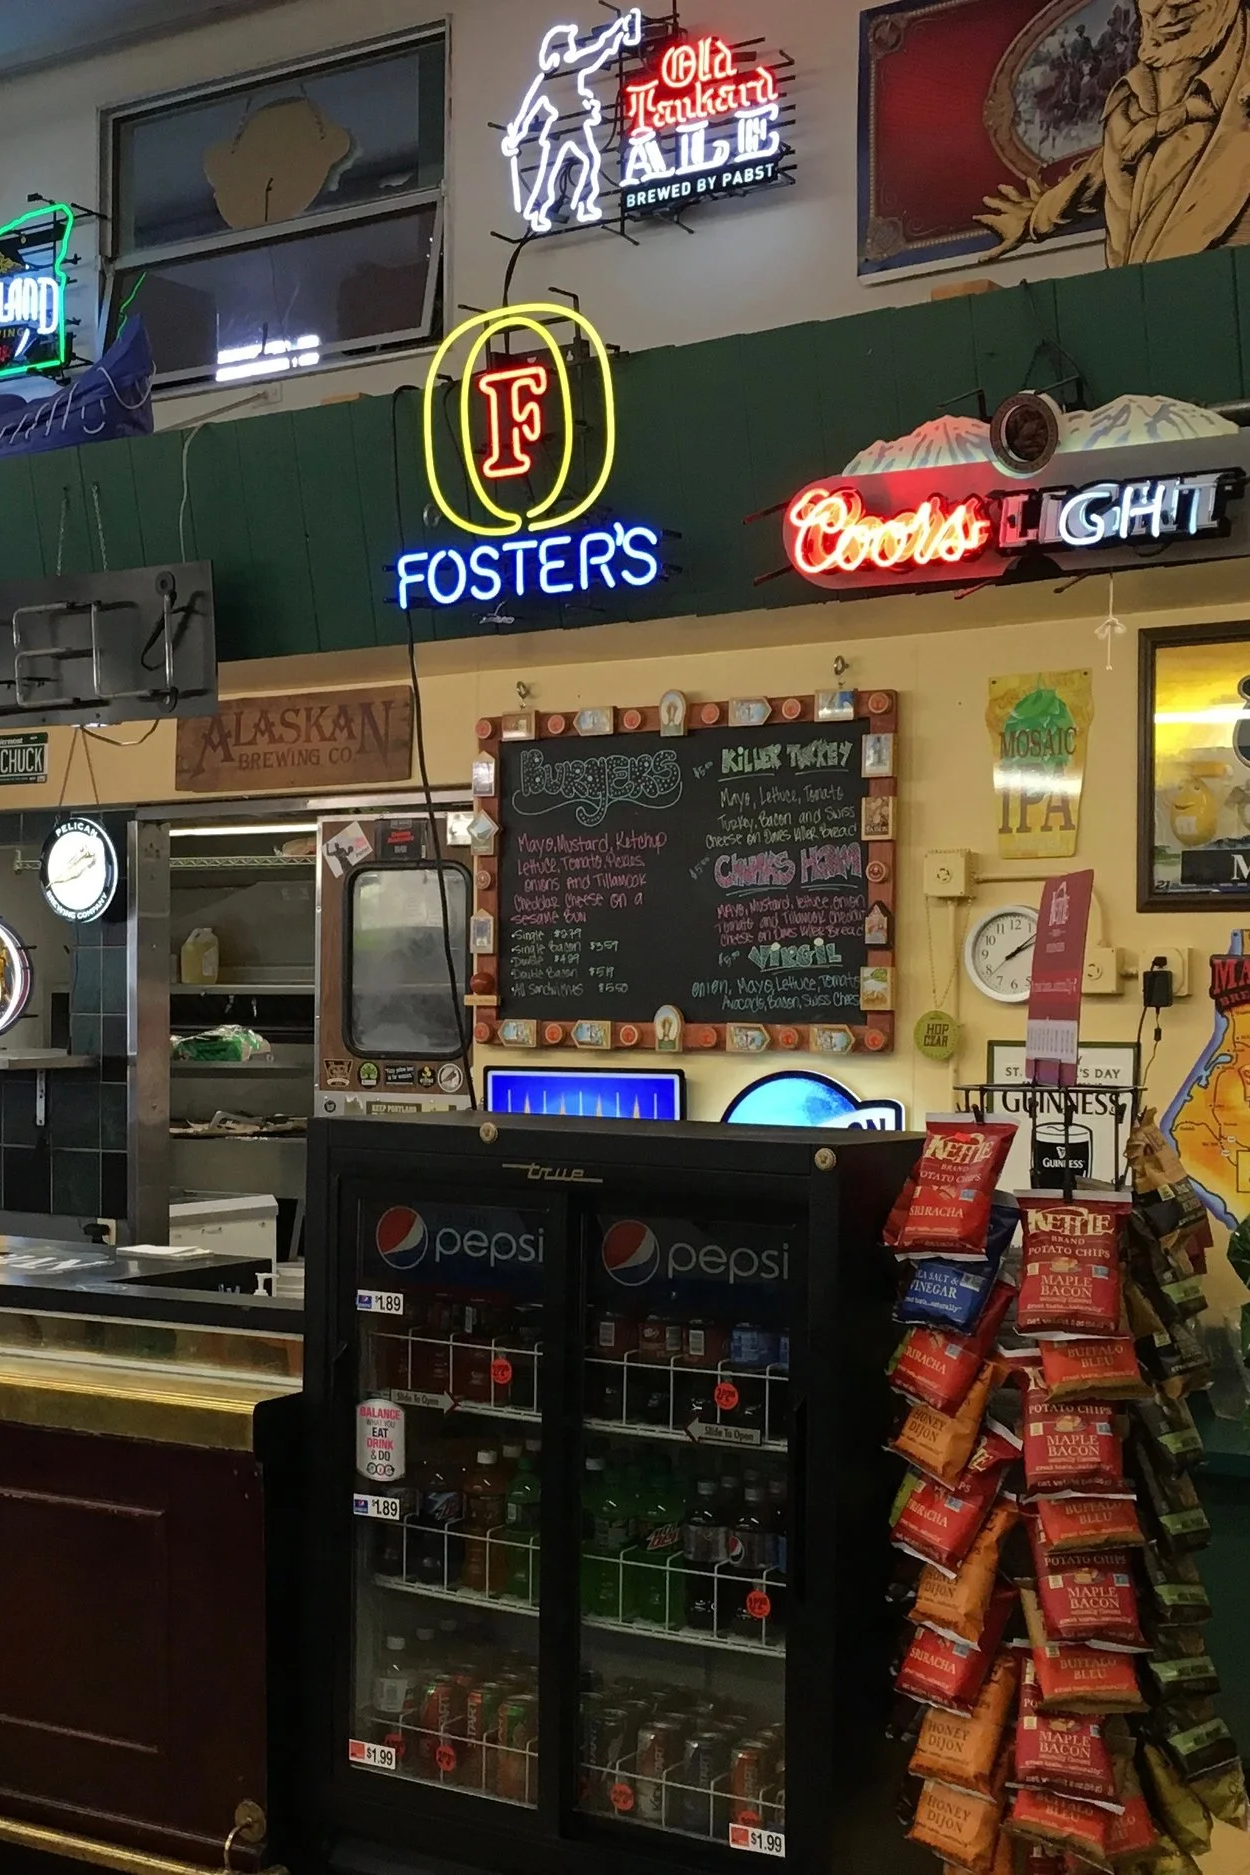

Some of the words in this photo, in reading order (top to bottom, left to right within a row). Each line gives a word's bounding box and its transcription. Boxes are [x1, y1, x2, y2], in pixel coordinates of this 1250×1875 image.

[662, 37, 737, 88] Old
[626, 66, 779, 136] Tankard
[620, 103, 780, 187] ALE
[626, 181, 692, 208] BREWED
[696, 175, 717, 191] BY
[723, 163, 776, 188] PABST
[479, 366, 547, 477] F
[790, 488, 989, 574] Coors
[999, 470, 1218, 549] LIGHT
[397, 522, 658, 609] FOSTER'S
[190, 700, 396, 780] ALASKAN
[1000, 726, 1078, 759] MOSAIC
[238, 749, 321, 771] BREWING
[997, 764, 1077, 834] IPA
[798, 808, 822, 824] and
[824, 805, 855, 821] Swiss
[55, 822, 98, 837] PELICAN
[76, 891, 108, 920] COMPANY
[995, 923, 1006, 935] 11
[1009, 918, 1022, 931] 12
[1026, 922, 1032, 933] 1
[985, 935, 996, 946] 10
[981, 949, 989, 960] 9
[985, 964, 993, 975] 8
[996, 976, 1004, 987] 7
[1010, 979, 1018, 990] 6
[925, 1023, 949, 1035] HOP
[923, 1034, 949, 1048] CZAR
[1005, 1066, 1023, 1078] ST.
[1094, 1068, 1122, 1080] DAY
[527, 1162, 586, 1182] true
[909, 1205, 964, 1219] SRIRACHA
[1027, 1205, 1115, 1237] KETTLE
[435, 1227, 545, 1267] pepsi
[1051, 1235, 1086, 1246] BRAND
[1028, 1244, 1073, 1257] POTATO
[1075, 1248, 1111, 1260] CHIPS
[667, 1243, 790, 1284] pepsi
[928, 1271, 950, 1284] SALT
[950, 1276, 959, 1287] &
[1040, 1274, 1093, 1288] MAPLE
[910, 1280, 958, 1299] VINEGAR
[1040, 1285, 1093, 1299] BACON
[374, 1293, 402, 1314] $1.89
[1067, 1343, 1124, 1359] BUFFALO
[1080, 1356, 1115, 1369] BLEU
[359, 1406, 401, 1420] BALANCE
[1027, 1403, 1076, 1416] POTATO
[1077, 1403, 1114, 1416] CHIPS
[912, 1407, 947, 1433] HONEY
[372, 1427, 389, 1439] EAT
[704, 1426, 723, 1437] Slide
[724, 1428, 733, 1438] To
[734, 1430, 754, 1443] Open
[908, 1420, 940, 1444] DIJON
[1046, 1434, 1100, 1447] MAPLE
[366, 1438, 394, 1450] DRINK
[1047, 1445, 1100, 1458] BACON
[370, 1450, 377, 1460] &
[378, 1450, 390, 1461] DO
[371, 1498, 398, 1517] $1.89
[1064, 1500, 1123, 1517] BUFFALO
[1078, 1512, 1112, 1526] BLEU
[1043, 1554, 1091, 1567] POTATO
[1092, 1554, 1127, 1566] CHIPS
[922, 1581, 957, 1601] DIJON
[1067, 1586, 1118, 1599] MAPLE
[1069, 1596, 1120, 1611] BACON
[909, 1646, 957, 1676] SRIRACHA
[1058, 1655, 1118, 1672] BUFFALO
[1072, 1667, 1108, 1681] BLEU
[926, 1721, 970, 1742] HONEY
[1038, 1730, 1092, 1748] MAPLE
[927, 1734, 965, 1754] DIJON
[1038, 1741, 1092, 1759] BACON
[367, 1749, 393, 1766] $1.99
[926, 1793, 972, 1821] HONEY
[925, 1808, 965, 1834] DIJON
[750, 1833, 782, 1853] $1.99
